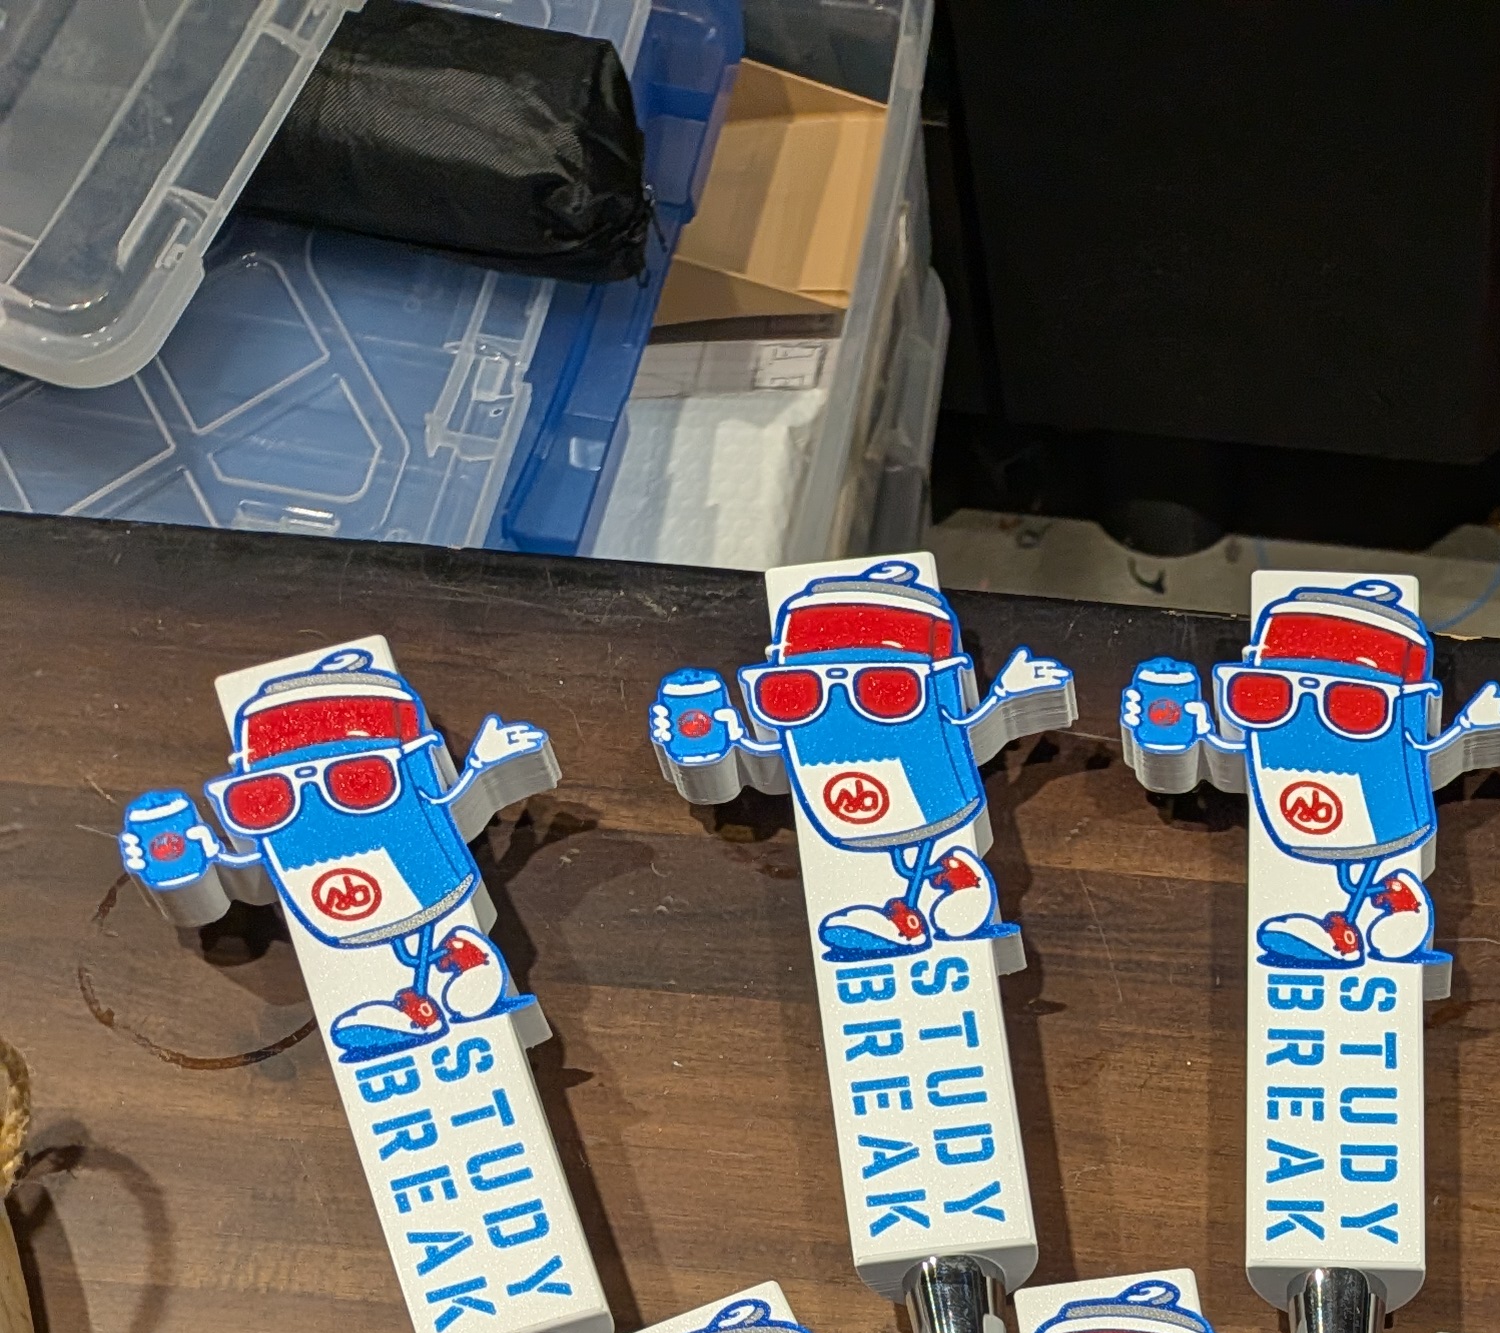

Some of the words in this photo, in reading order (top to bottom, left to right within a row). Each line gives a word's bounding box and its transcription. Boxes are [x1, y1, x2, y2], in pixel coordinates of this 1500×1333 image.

[356, 1056, 496, 1333] BREAK
[432, 1036, 573, 1298] STUDY
[836, 961, 931, 1238] BREAK
[912, 958, 1005, 1223] STUDY
[1266, 973, 1327, 1241] BREAK
[1339, 976, 1399, 1244] STUDY
